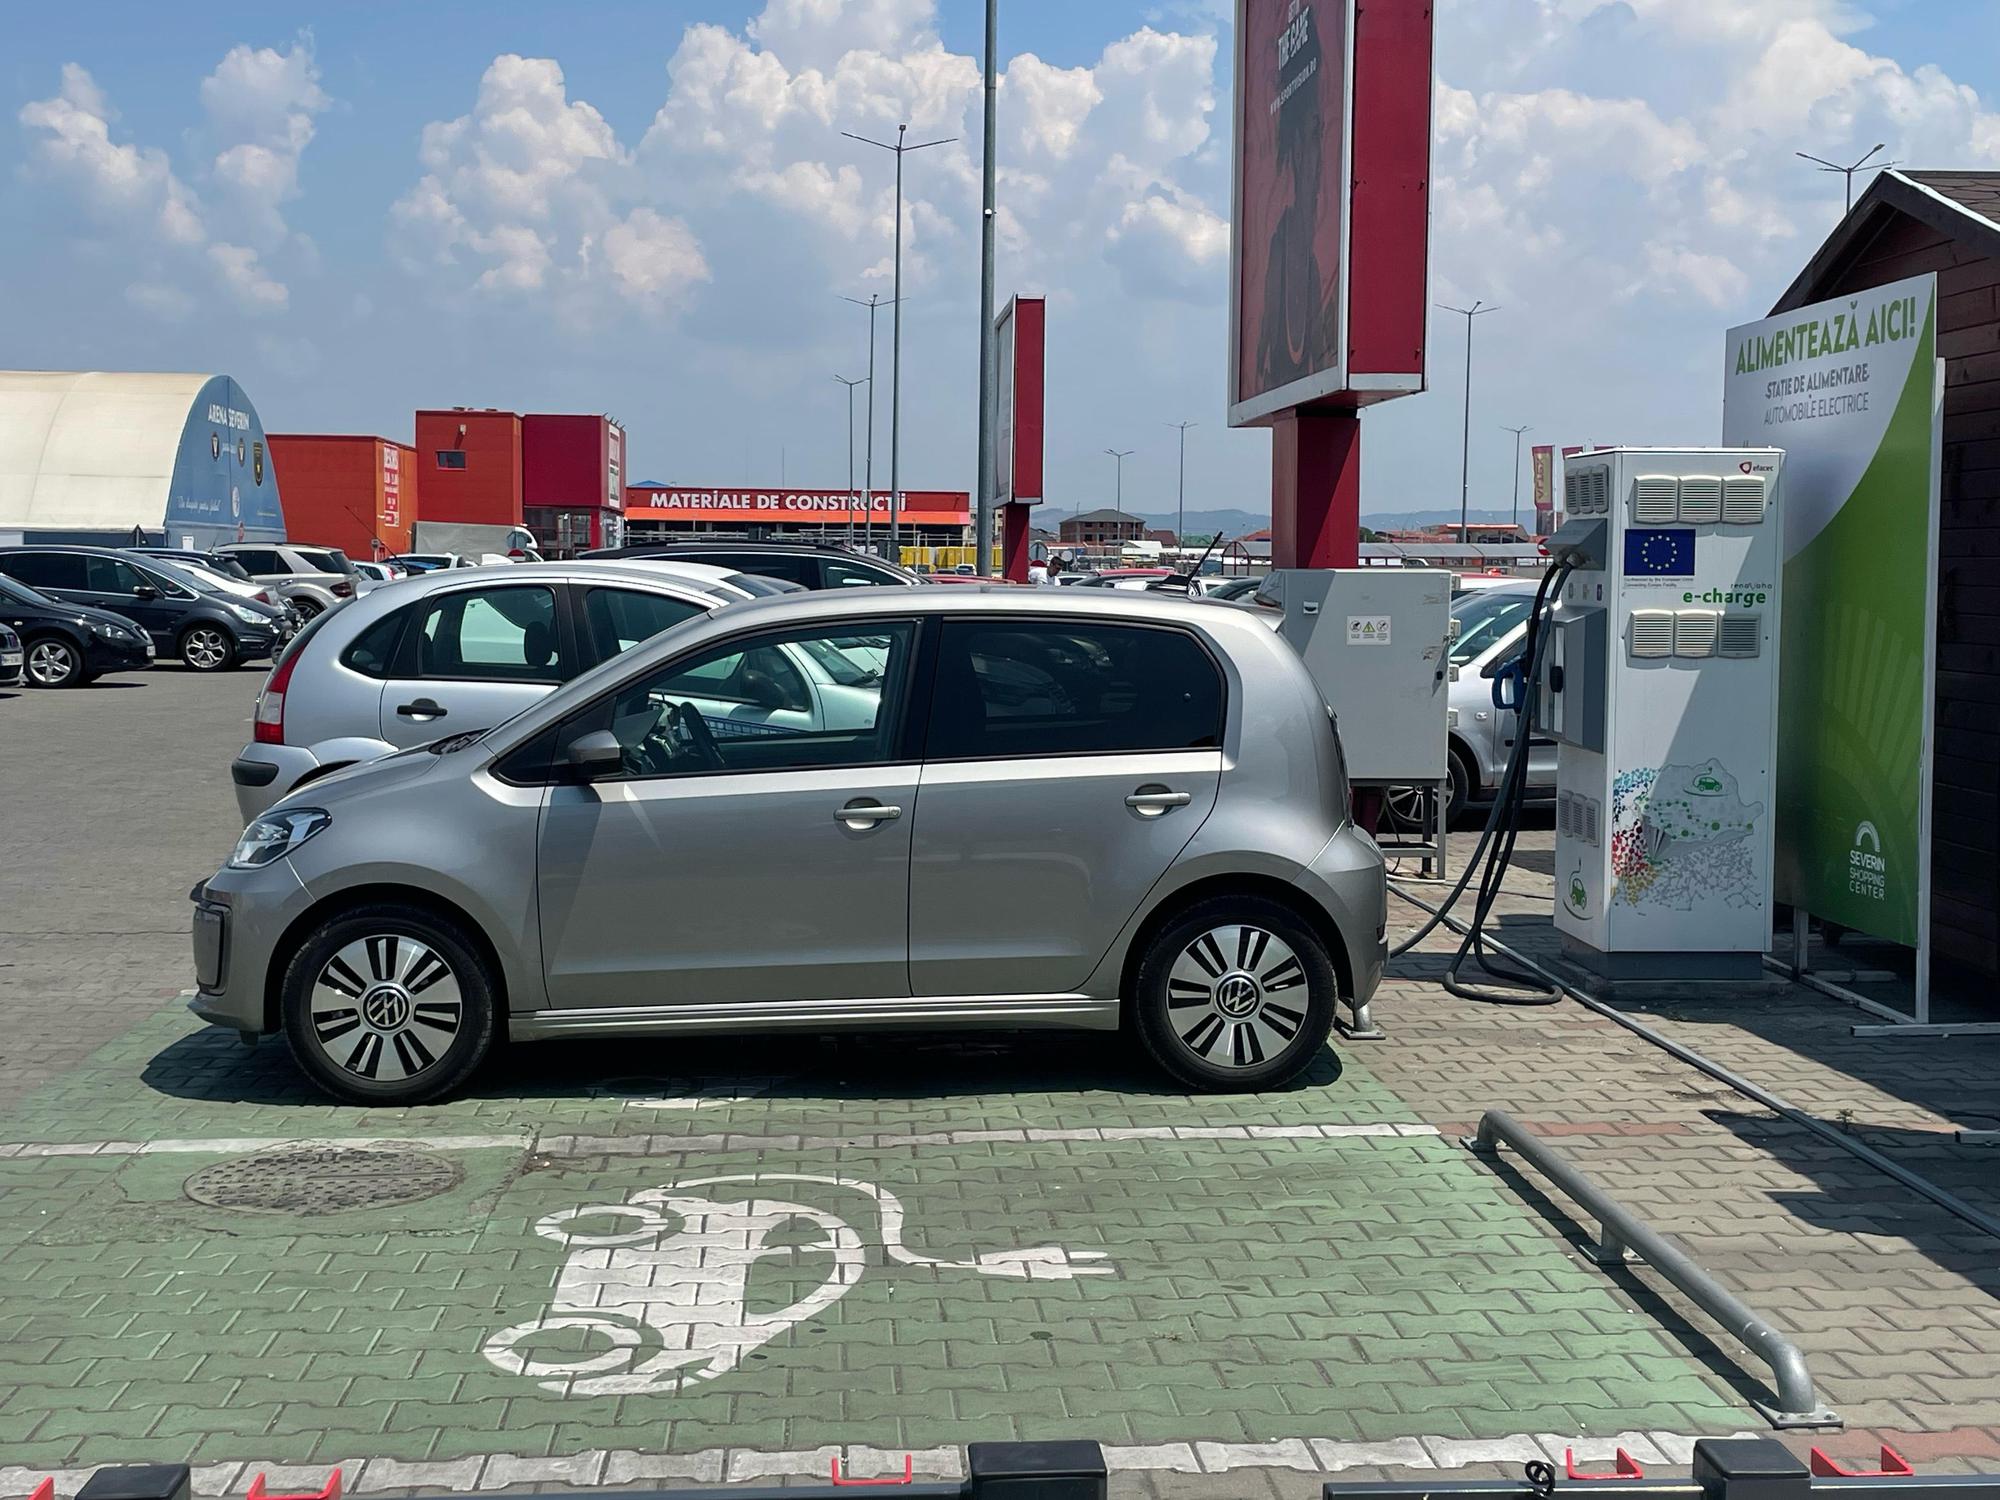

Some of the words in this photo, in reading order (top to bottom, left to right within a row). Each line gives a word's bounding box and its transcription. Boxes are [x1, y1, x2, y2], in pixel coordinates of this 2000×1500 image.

[1278, 28, 1290, 70] THE
[1735, 301, 1860, 375] ALIMENTEAZĂ
[1864, 295, 1916, 347] AICI!
[1794, 375, 1805, 393] DE
[1806, 363, 1870, 393] ALIMENTARE
[207, 403, 228, 427] ARENA
[1763, 400, 1816, 426] AUTOMOBILE
[1818, 392, 1870, 418] ELECTRICE
[756, 494, 780, 510] DE
[1682, 587, 1767, 608] e-charge
[1850, 849, 1885, 872] SEVERIN
[1849, 867, 1885, 888] SHOPPING
[1849, 880, 1885, 901] CENTER
